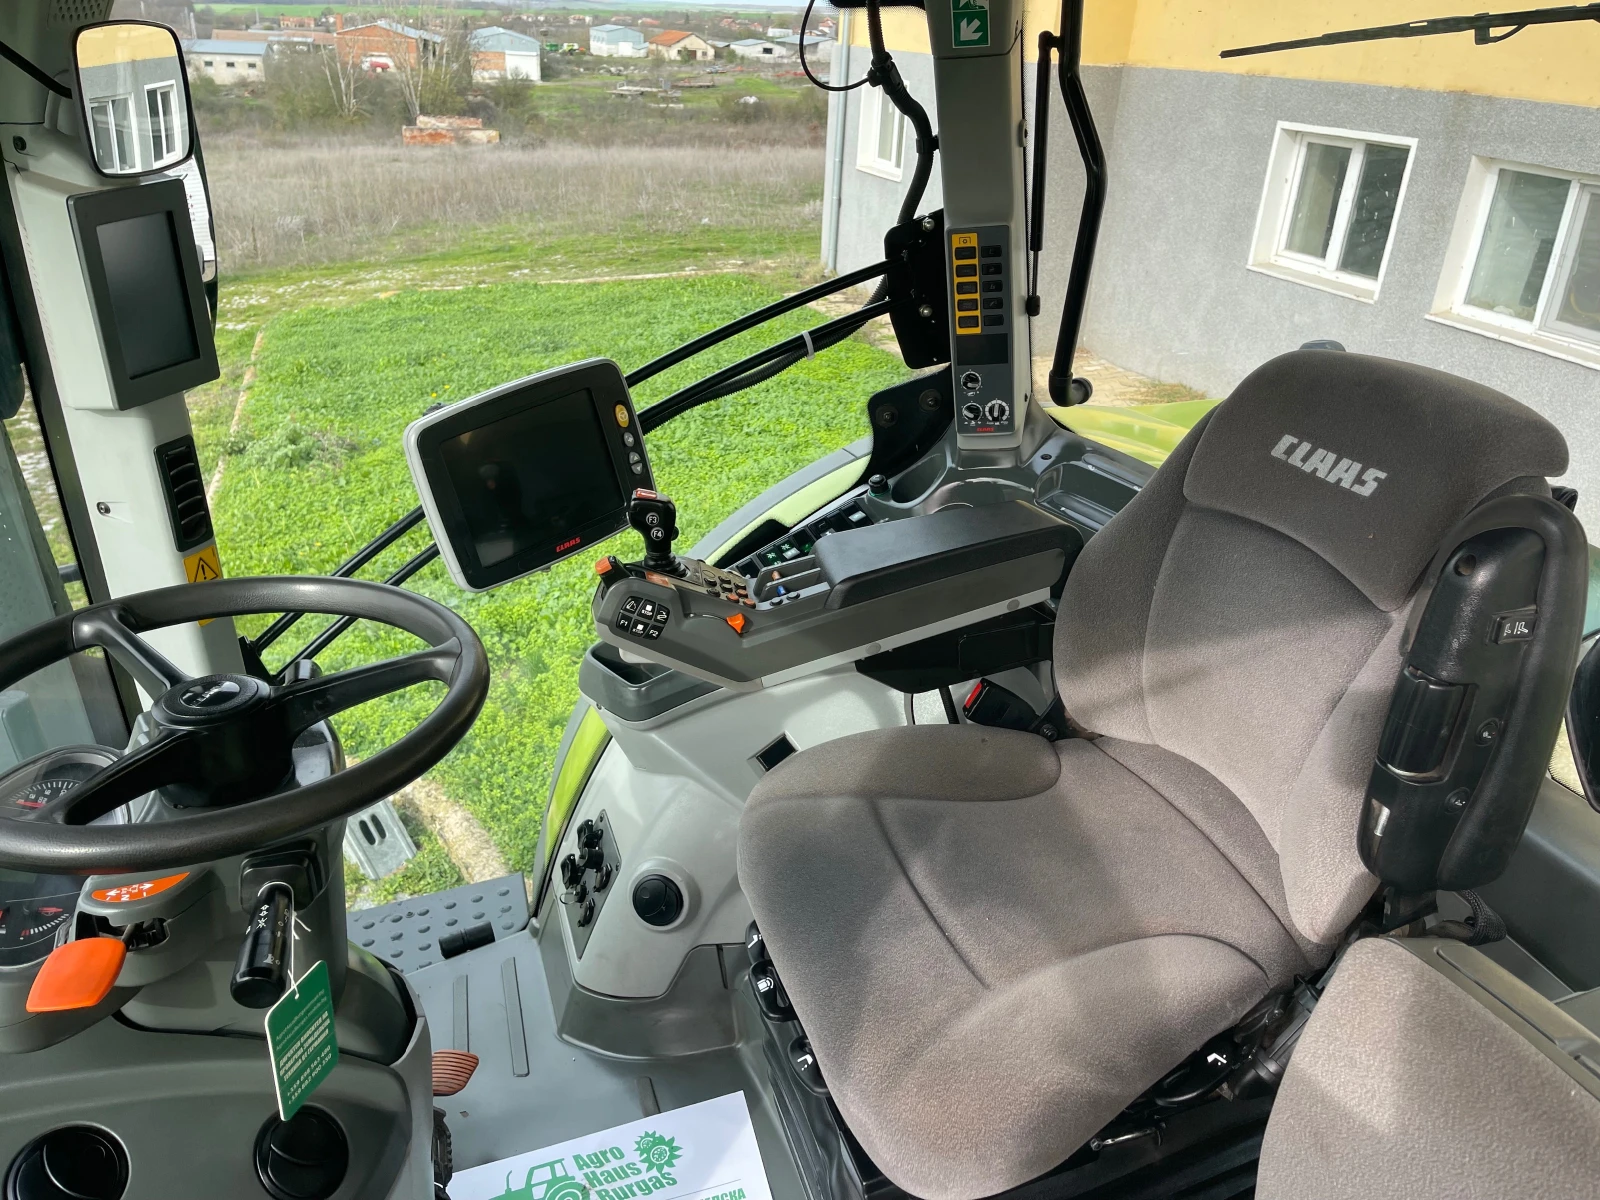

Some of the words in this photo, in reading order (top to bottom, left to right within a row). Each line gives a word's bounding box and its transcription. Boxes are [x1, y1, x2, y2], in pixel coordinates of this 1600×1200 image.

[1270, 434, 1388, 496] CLAAS
[556, 537, 580, 552] CLAAS
[619, 619, 628, 627] F1
[649, 629, 658, 637] F2
[572, 1146, 625, 1171] Agro
[583, 1162, 643, 1189] Haus
[595, 1172, 678, 1200] Burgas
